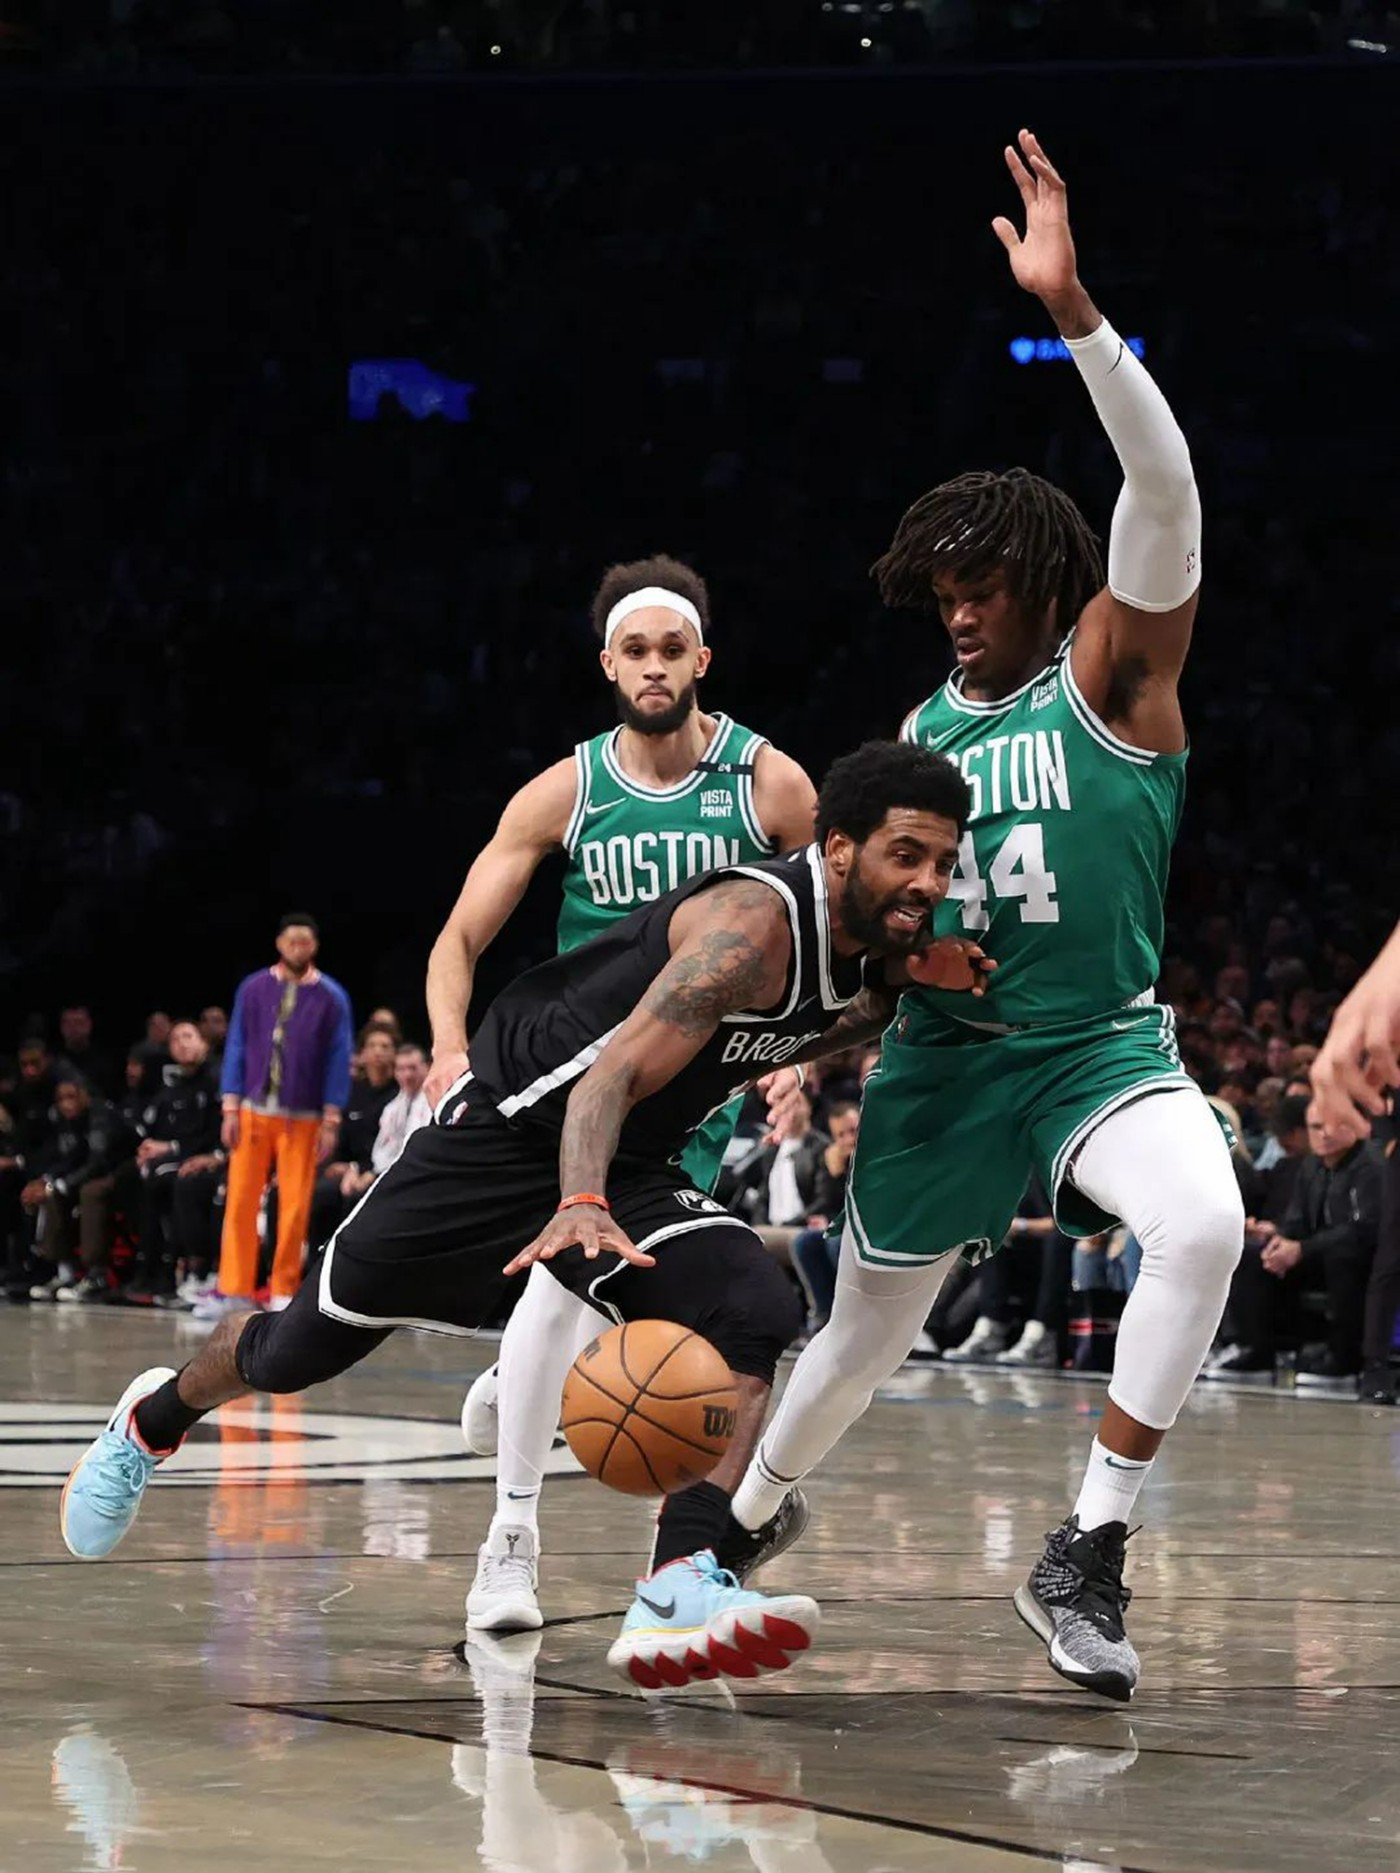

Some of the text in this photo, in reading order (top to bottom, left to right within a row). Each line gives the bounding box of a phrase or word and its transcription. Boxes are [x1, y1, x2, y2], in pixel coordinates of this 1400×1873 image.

[717, 763, 731, 773] 24
[946, 730, 1071, 822] STON
[700, 789, 733, 805] VISTA
[700, 805, 733, 818] PRINT
[945, 823, 1060, 931] 44
